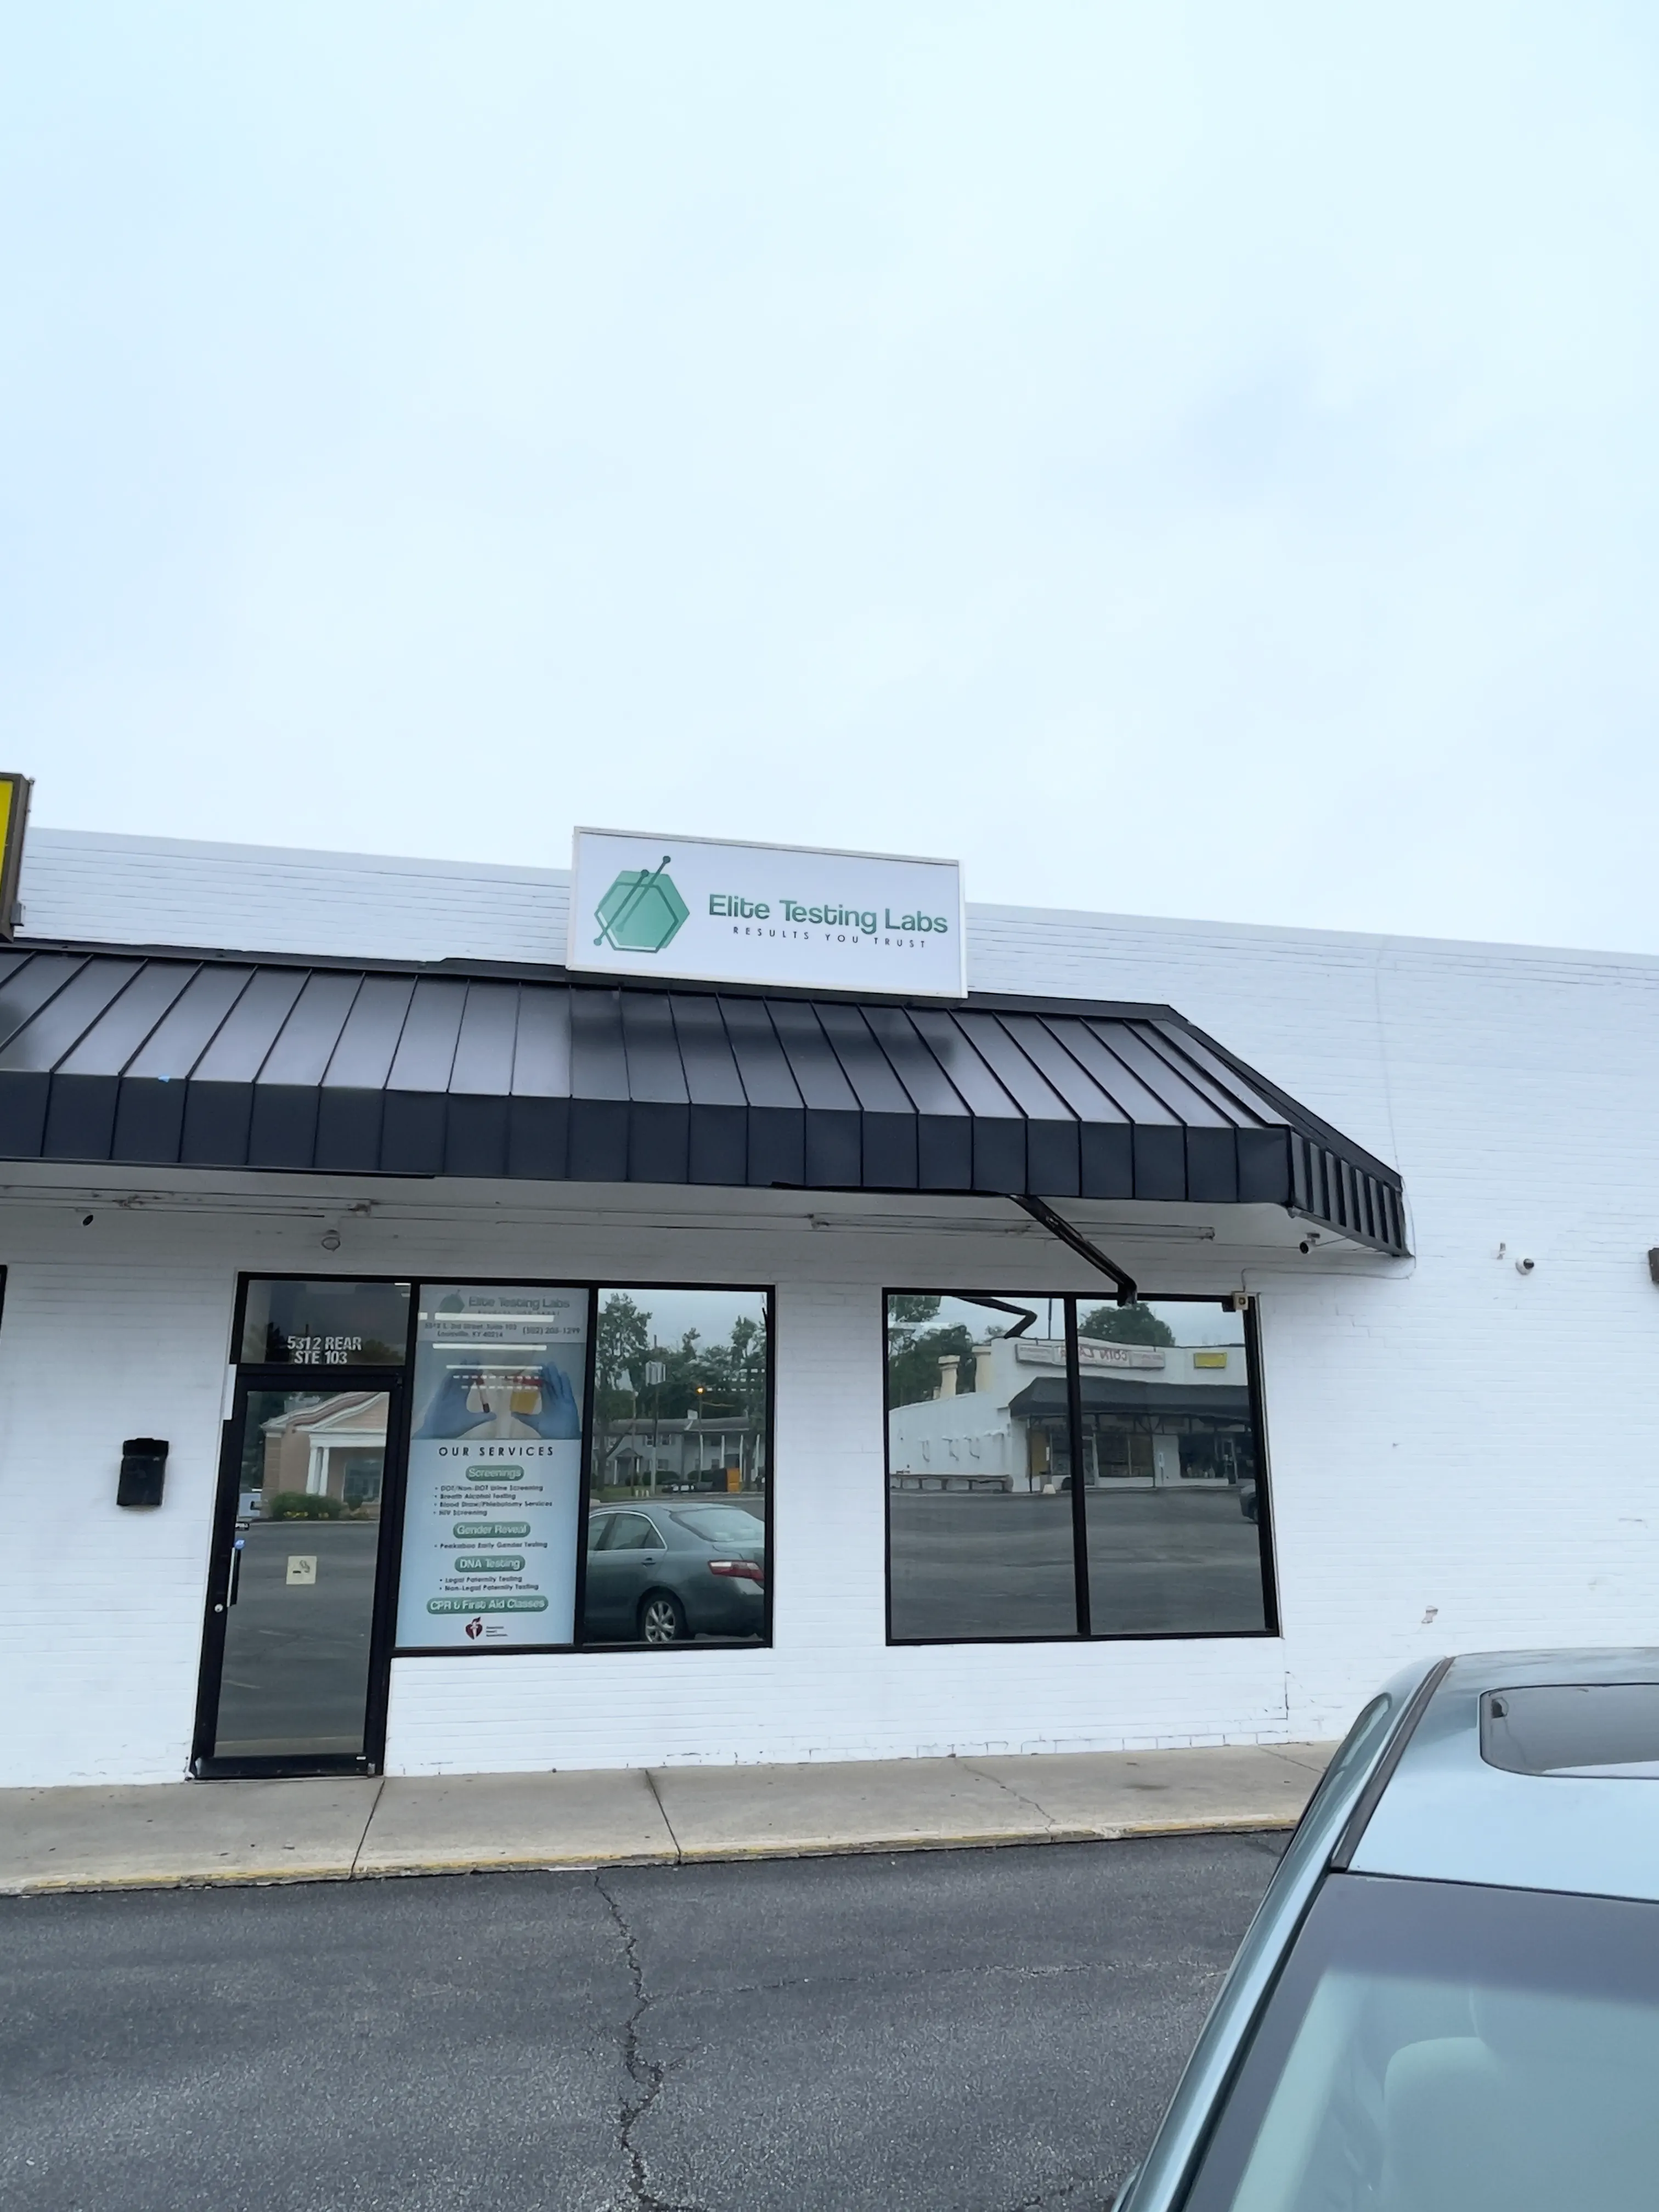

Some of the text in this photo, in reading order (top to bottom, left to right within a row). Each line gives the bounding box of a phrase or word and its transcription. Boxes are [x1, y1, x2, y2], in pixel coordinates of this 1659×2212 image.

[709, 894, 948, 934] Elite Testing Labs
[733, 926, 927, 948] RESULTS YOU TRUST
[543, 1298, 570, 1308] Labs
[287, 1335, 362, 1351] 5312 REAR
[294, 1351, 347, 1364] STE 103
[439, 1447, 554, 1456] OUR SERVICES
[469, 1468, 522, 1479] Screenings
[456, 1525, 527, 1534] Gender Reveal
[460, 1559, 520, 1570] DNA Testing
[430, 1600, 452, 1610] CPR
[462, 1600, 487, 1610] First
[488, 1599, 505, 1609] Aid
[507, 1598, 545, 1608] Classes
